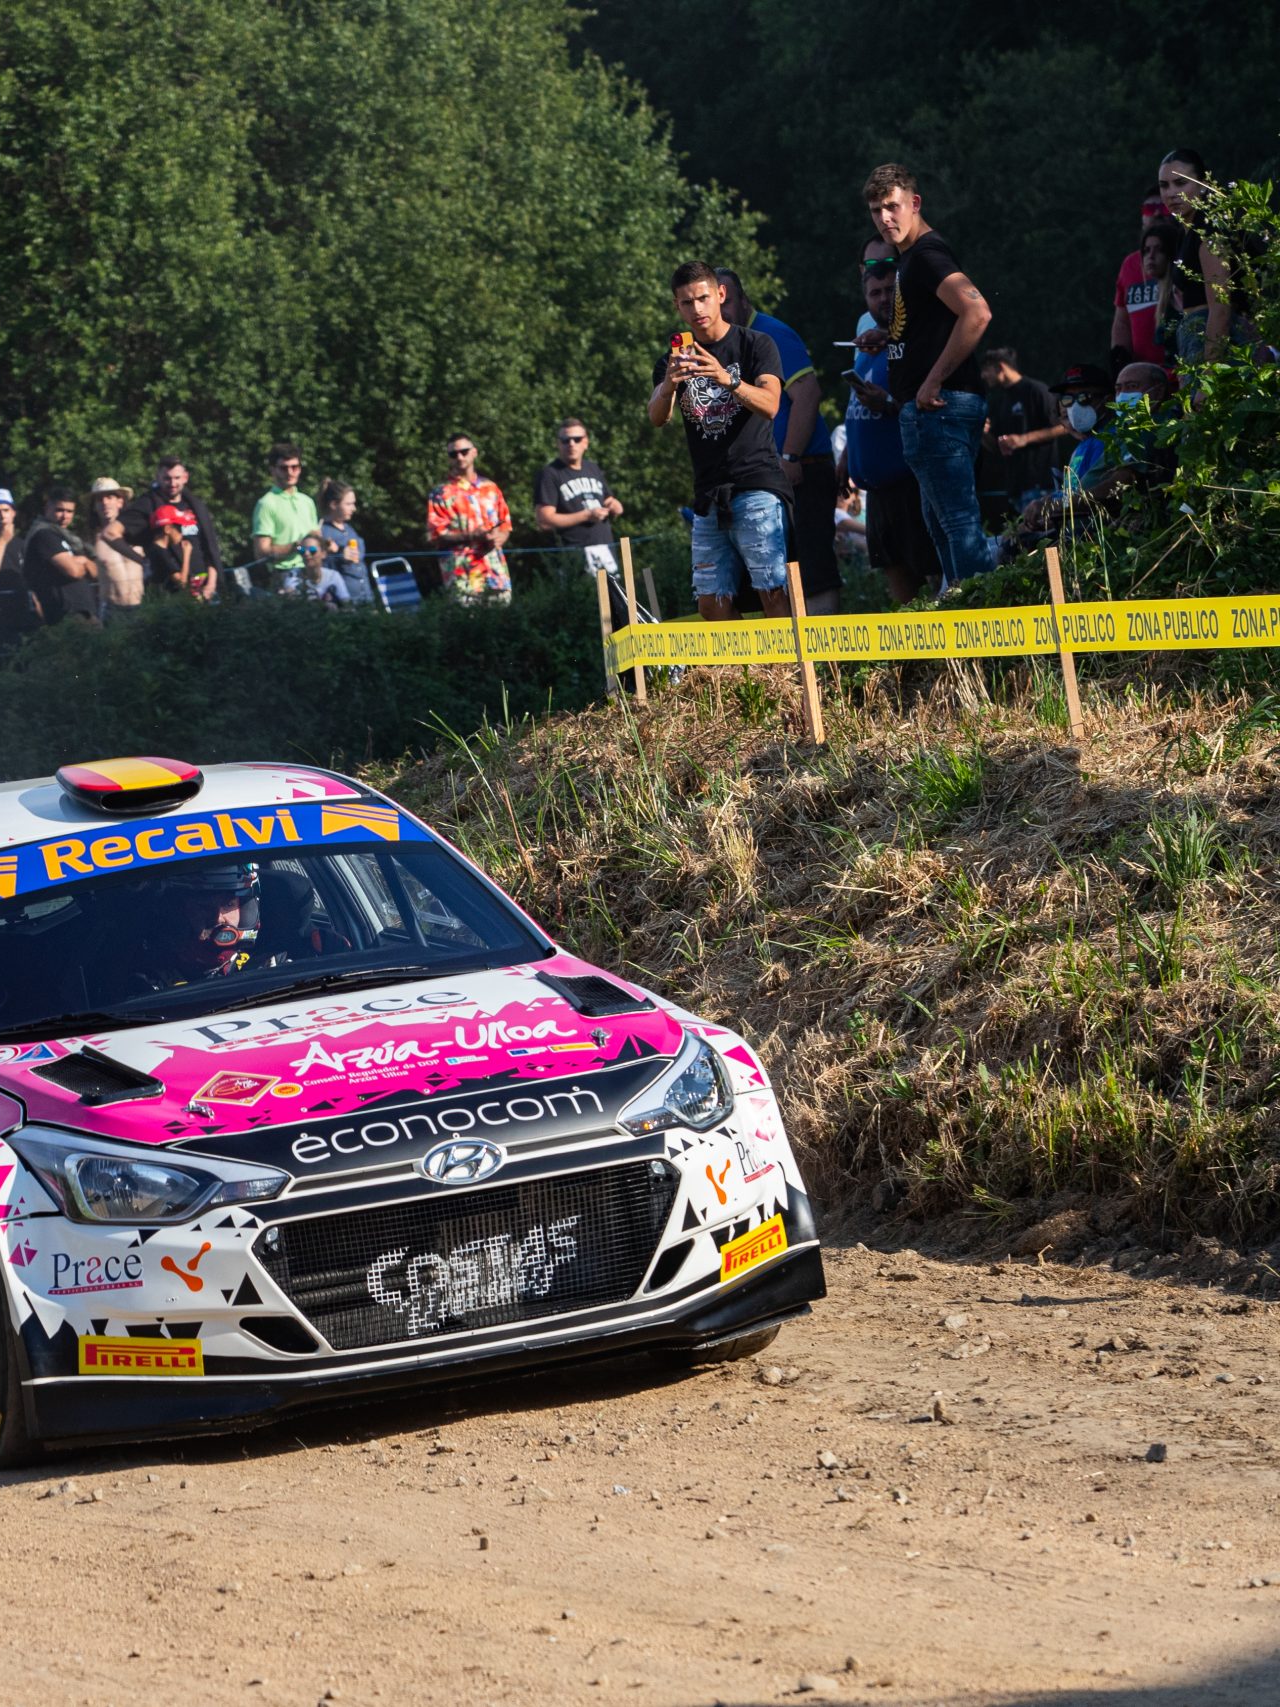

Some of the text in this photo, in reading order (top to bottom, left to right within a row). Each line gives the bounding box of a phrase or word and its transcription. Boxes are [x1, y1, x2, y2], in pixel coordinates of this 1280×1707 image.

[726, 631, 751, 656] PUBLICO
[755, 630, 771, 655] ZONA
[805, 627, 831, 653] ZONA
[830, 625, 870, 653] PUBLICO
[878, 625, 906, 652] ZONA
[905, 622, 946, 650] PUBLICO
[954, 621, 983, 649] ZONA
[982, 618, 1025, 648] PUBLICO
[1062, 613, 1115, 644] PUBLICO
[1126, 611, 1162, 642] ZONA
[1163, 609, 1219, 640] PUBLICO
[1231, 607, 1267, 638] ZONA
[38, 808, 303, 881] Recalvi
[183, 991, 468, 1045] Prace
[303, 1058, 440, 1087] Consello Regulador da DOP
[291, 1089, 604, 1163] econocom
[51, 1252, 142, 1289] Prace
[724, 1223, 783, 1273] PIRELLI
[84, 1343, 196, 1368] PIRELLI
